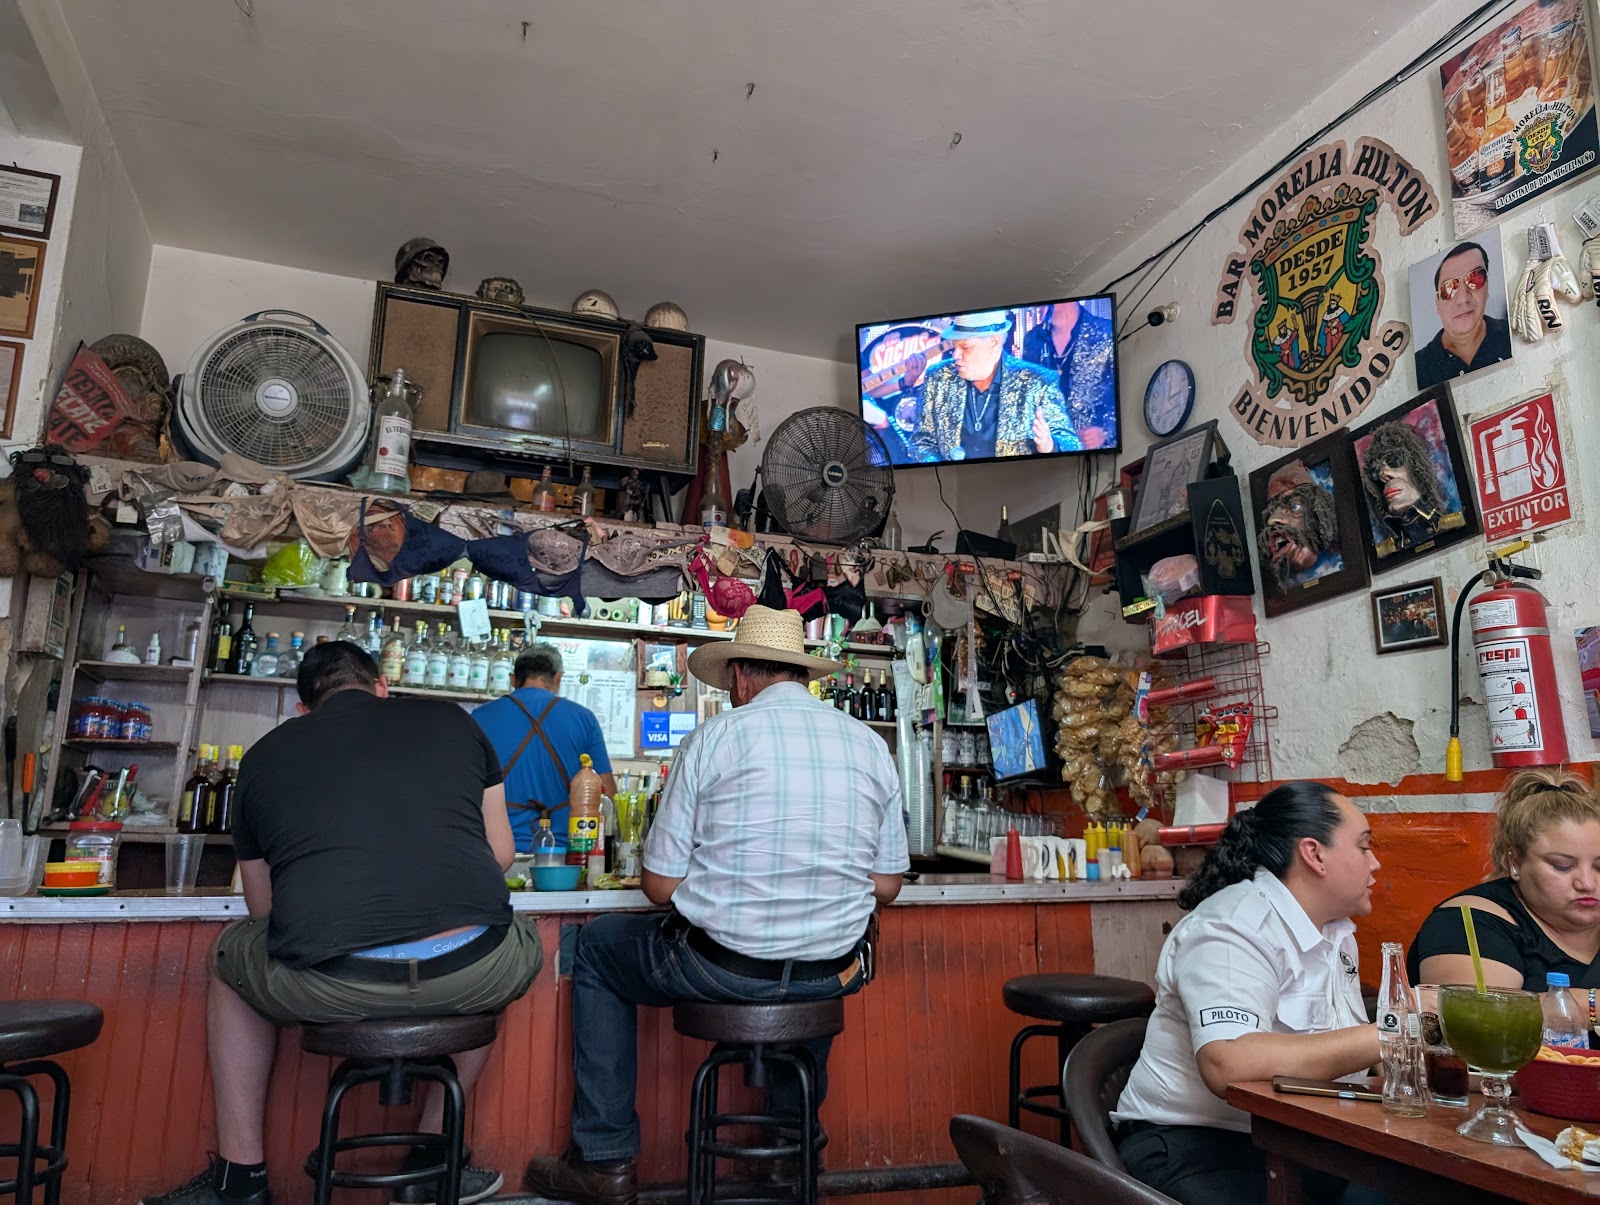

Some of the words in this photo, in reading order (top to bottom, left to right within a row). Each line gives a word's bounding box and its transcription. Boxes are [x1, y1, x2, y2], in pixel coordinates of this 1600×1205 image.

[1504, 138, 1514, 156] BAR
[1513, 104, 1548, 134] MORELIA
[1553, 102, 1577, 121] HILTON
[1528, 125, 1550, 140] DESDE
[1531, 132, 1547, 144] 1957
[1216, 258, 1246, 318] BAR
[1243, 148, 1342, 247] MORELIA
[1353, 145, 1432, 228] HILTON
[1279, 229, 1344, 277] DESDE
[1288, 255, 1334, 292] 1957
[1235, 328, 1404, 441] BIENVENIDOS
[1488, 492, 1565, 529] EXTINTOR
[1479, 648, 1520, 662] respi
[647, 733, 668, 742] VISA
[432, 939, 467, 953] Calvin
[1211, 1010, 1249, 1022] PILOTO
[1387, 1016, 1394, 1024] 2
